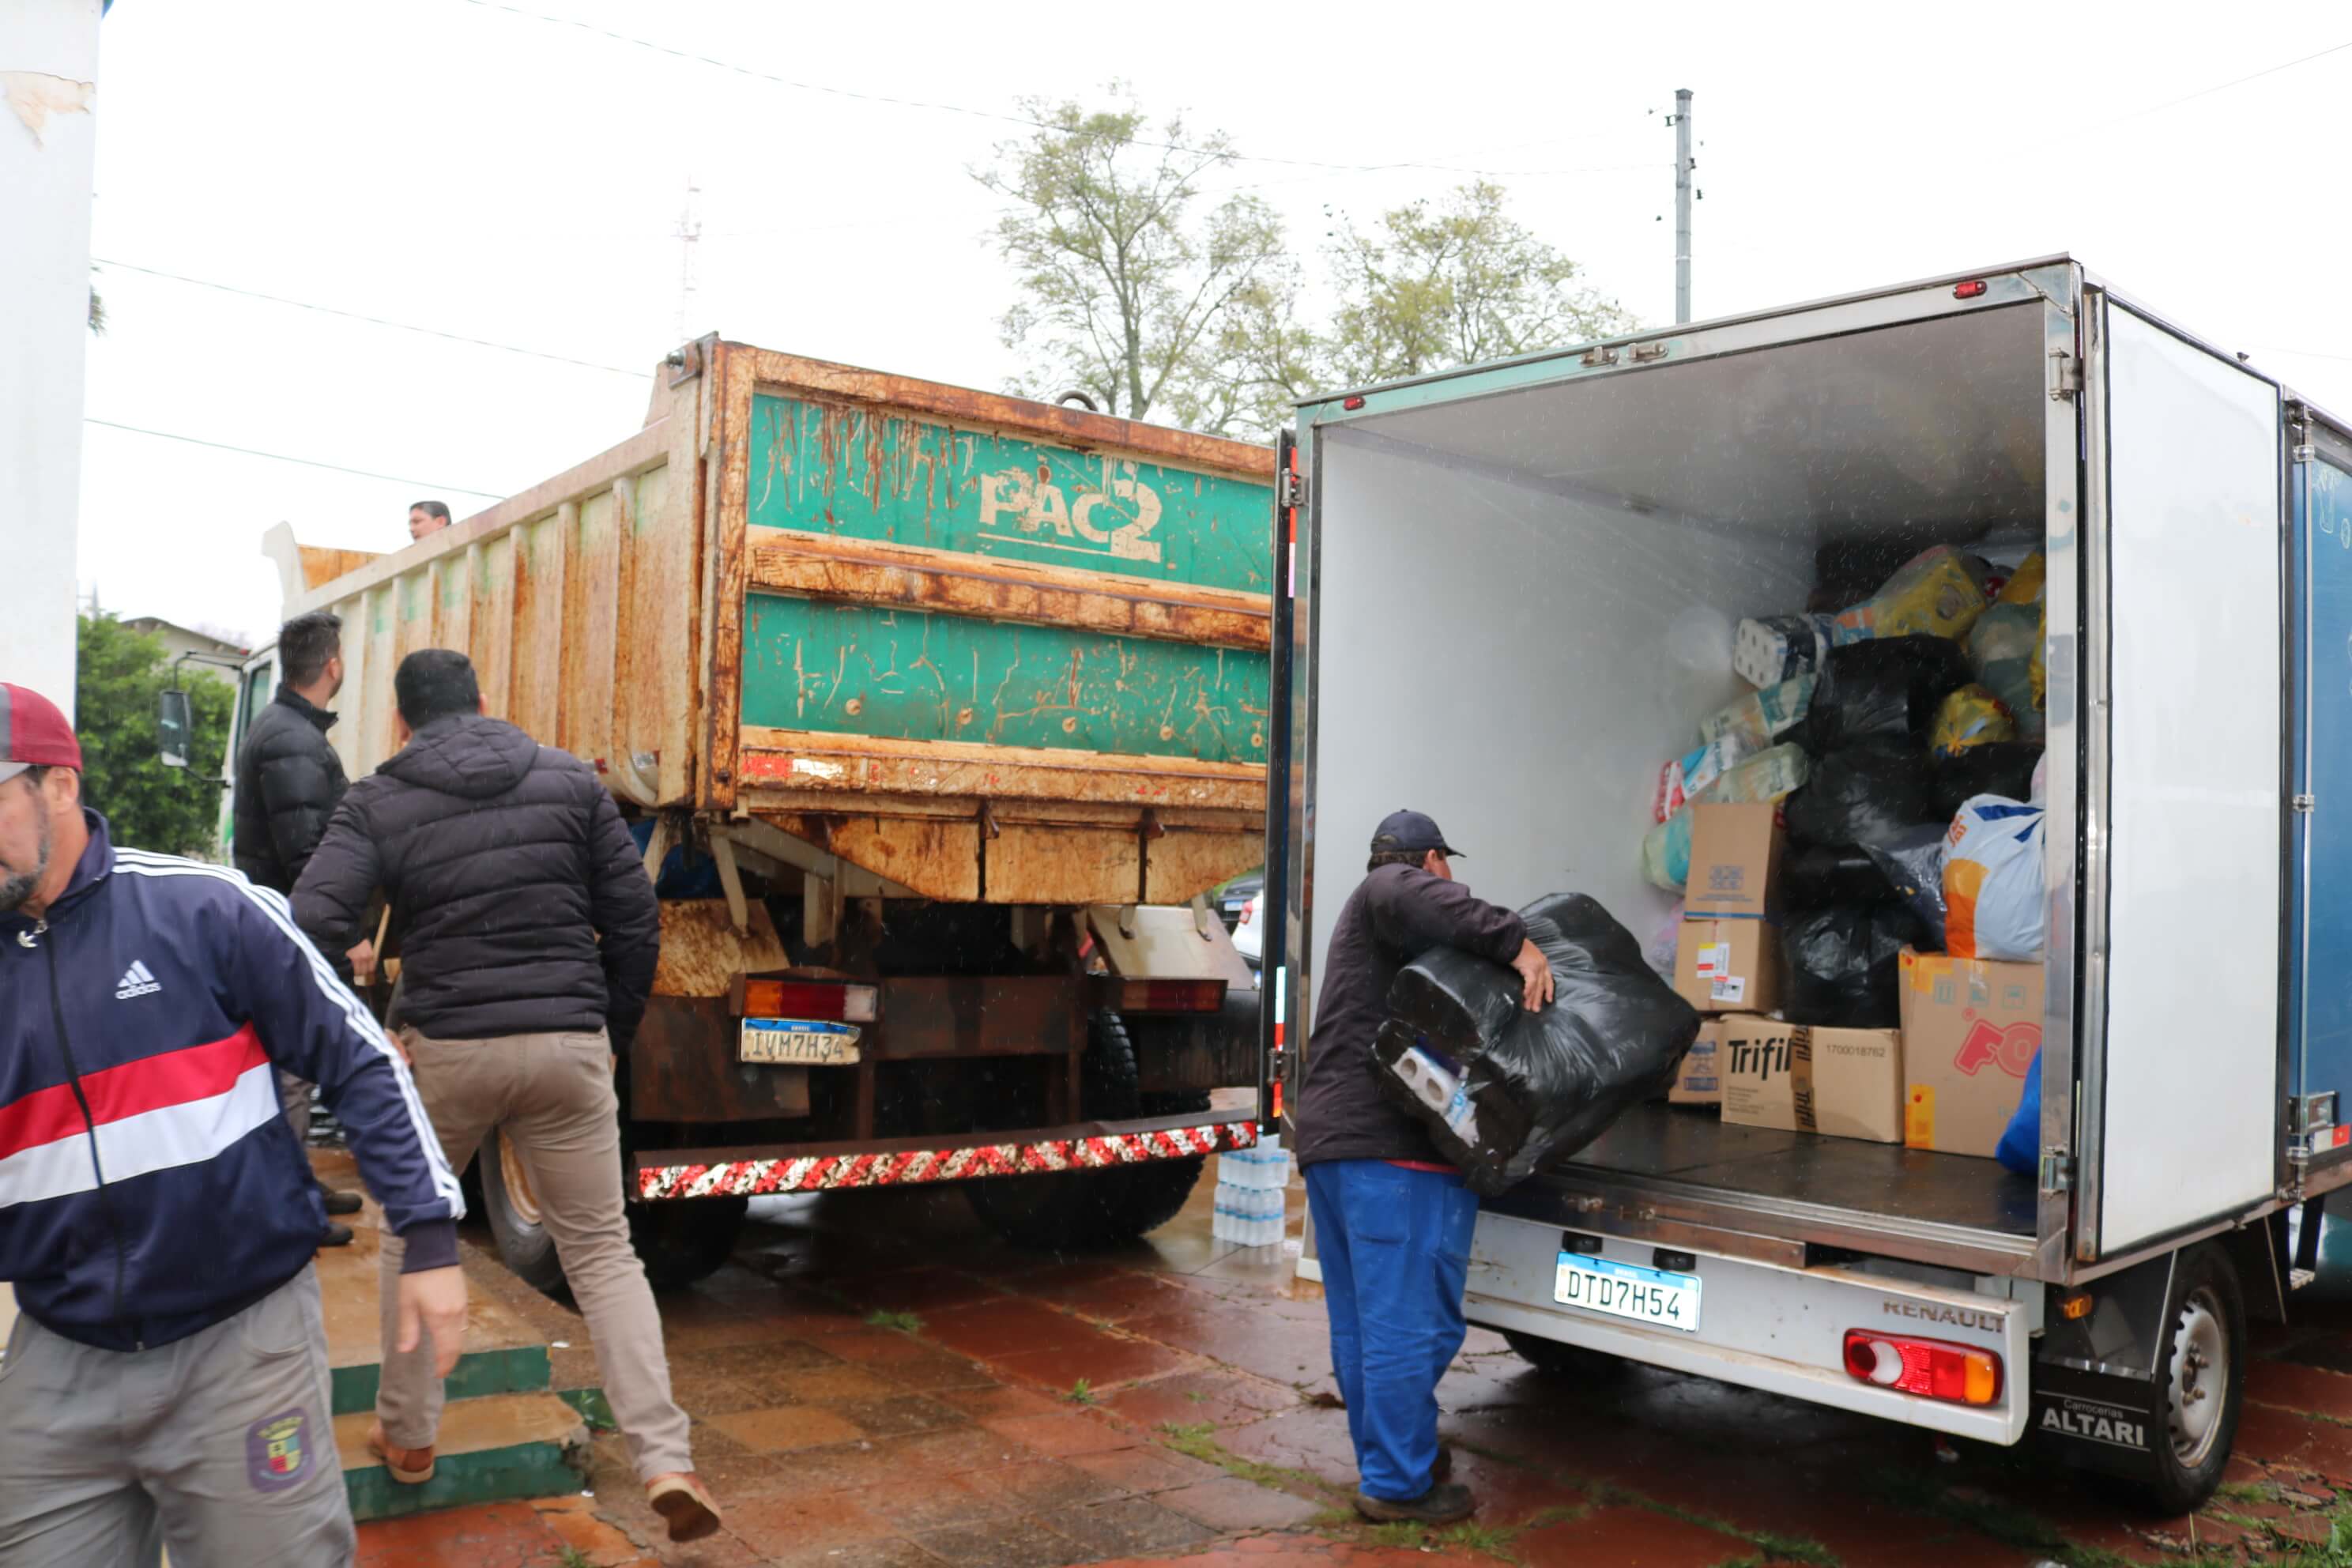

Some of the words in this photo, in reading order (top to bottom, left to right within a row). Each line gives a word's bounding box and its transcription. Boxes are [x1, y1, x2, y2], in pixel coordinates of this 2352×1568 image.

[979, 465, 1163, 564] PAC2
[115, 982, 161, 1000] adidas
[1728, 1037, 1795, 1081] Trifil
[1567, 1270, 1680, 1321] DTD7H54
[1883, 1301, 2005, 1333] RENAULT
[2041, 1407, 2144, 1446] ALTARI
